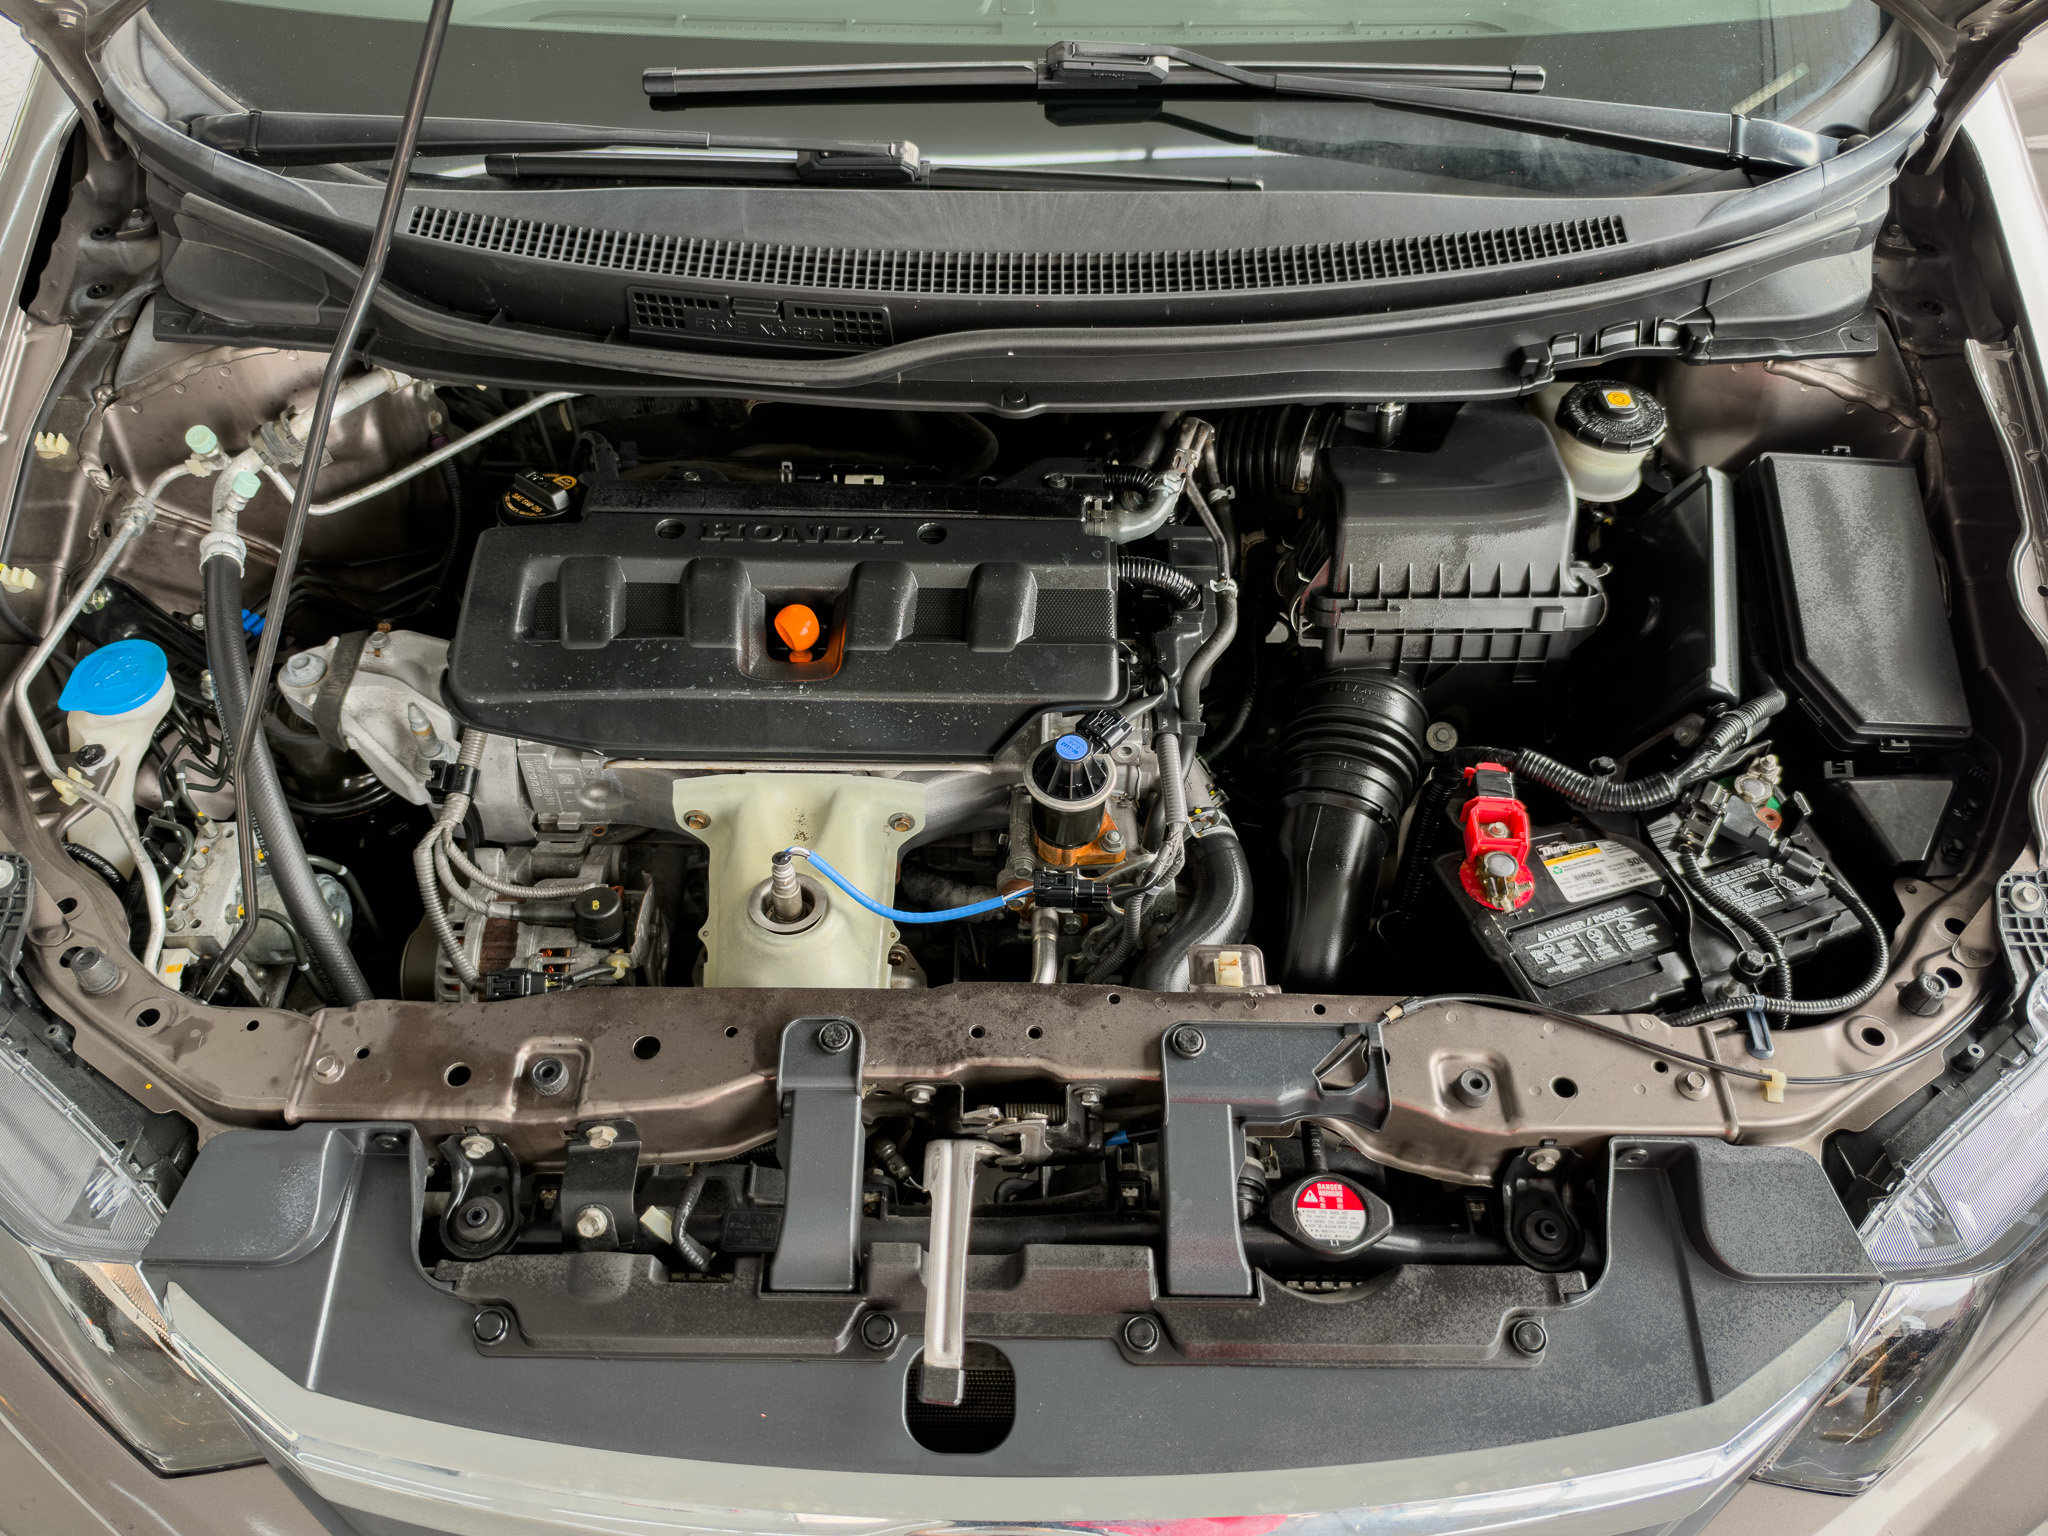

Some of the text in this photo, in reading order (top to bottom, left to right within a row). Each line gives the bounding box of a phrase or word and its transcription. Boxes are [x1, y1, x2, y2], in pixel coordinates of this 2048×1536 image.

[695, 317, 824, 340] FRAME NUMBER
[511, 493, 523, 502] SAE
[700, 523, 904, 545] HONDA
[1545, 920, 1587, 939] DANGER
[1593, 906, 1630, 924] POISON
[1317, 1190, 1344, 1198] WARNING
